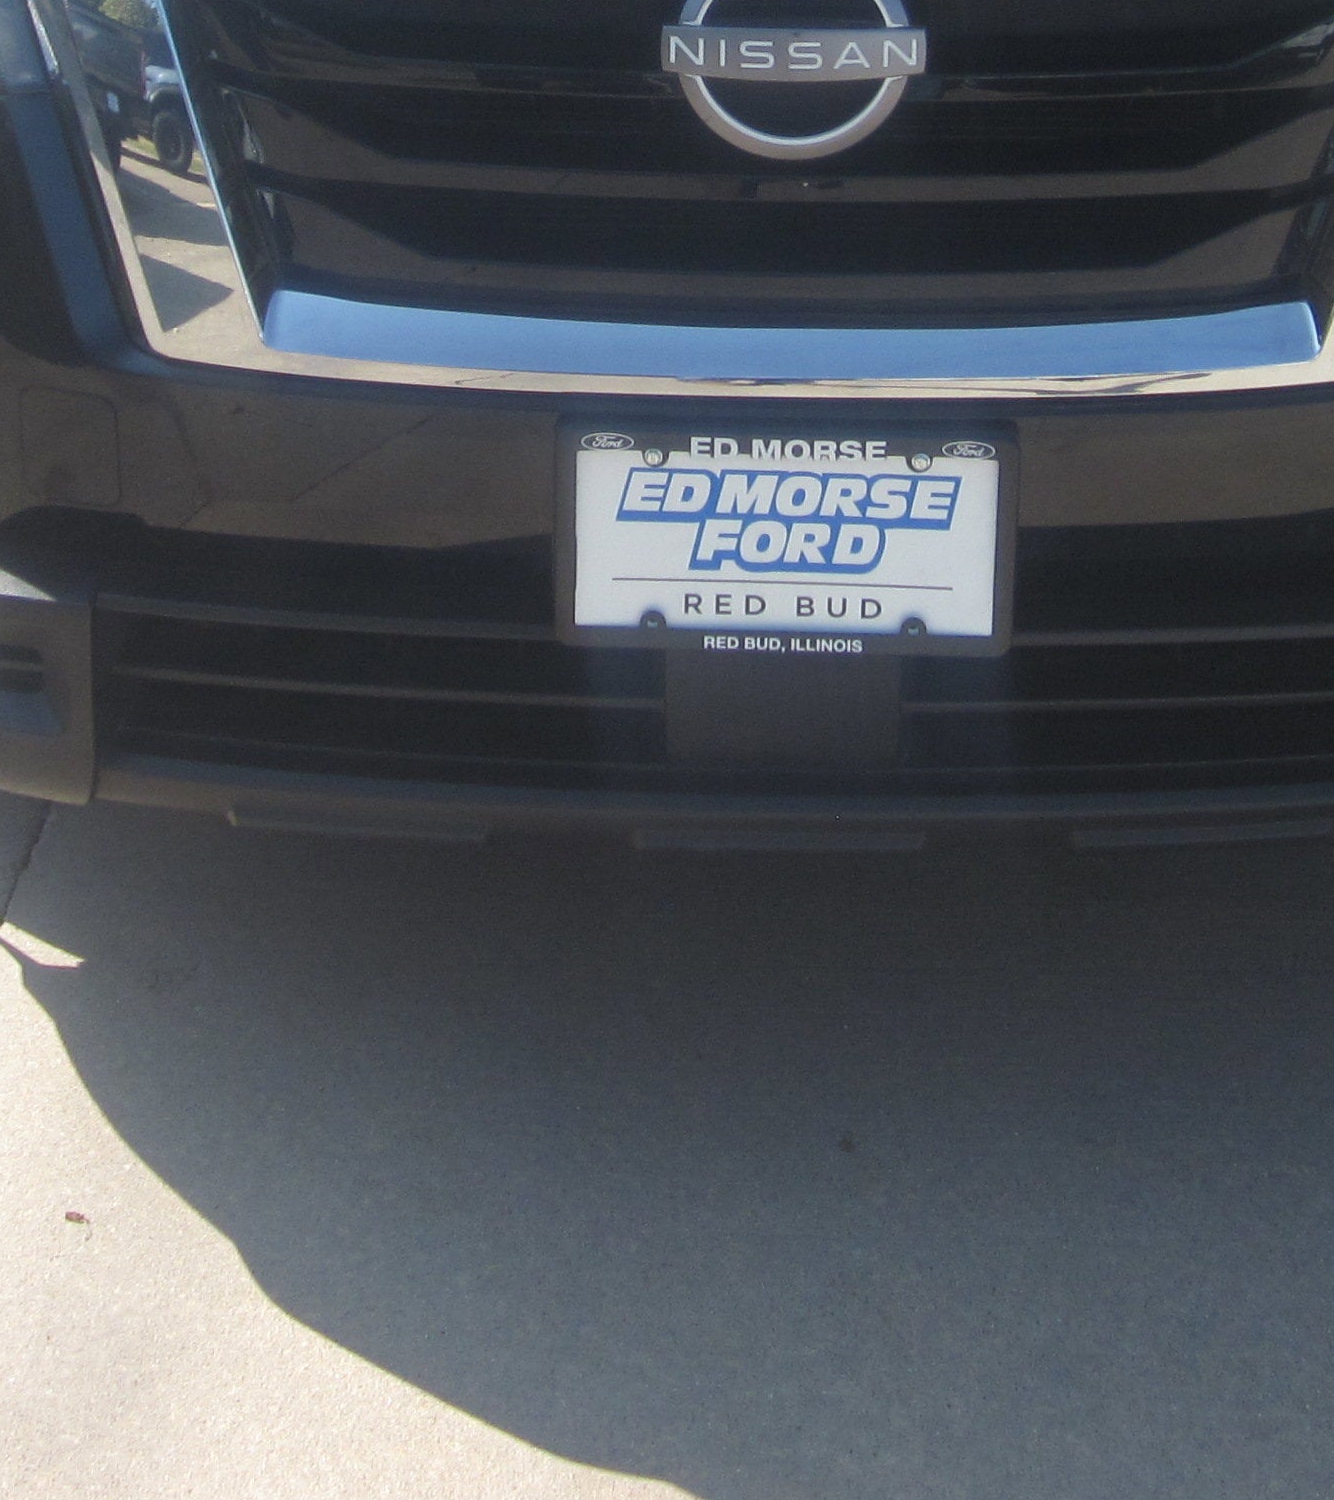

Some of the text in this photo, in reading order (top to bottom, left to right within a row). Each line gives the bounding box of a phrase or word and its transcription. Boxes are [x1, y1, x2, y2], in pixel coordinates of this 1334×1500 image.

[668, 35, 918, 71] NISSAN
[591, 434, 622, 449] Ford
[689, 436, 887, 462] ED MORSE
[952, 443, 984, 458] Ford
[620, 470, 957, 521] ED MORSE
[695, 518, 881, 566] FORD
[683, 592, 882, 619] RED BUD
[702, 635, 864, 653] RED BUD, ILLINOIS
